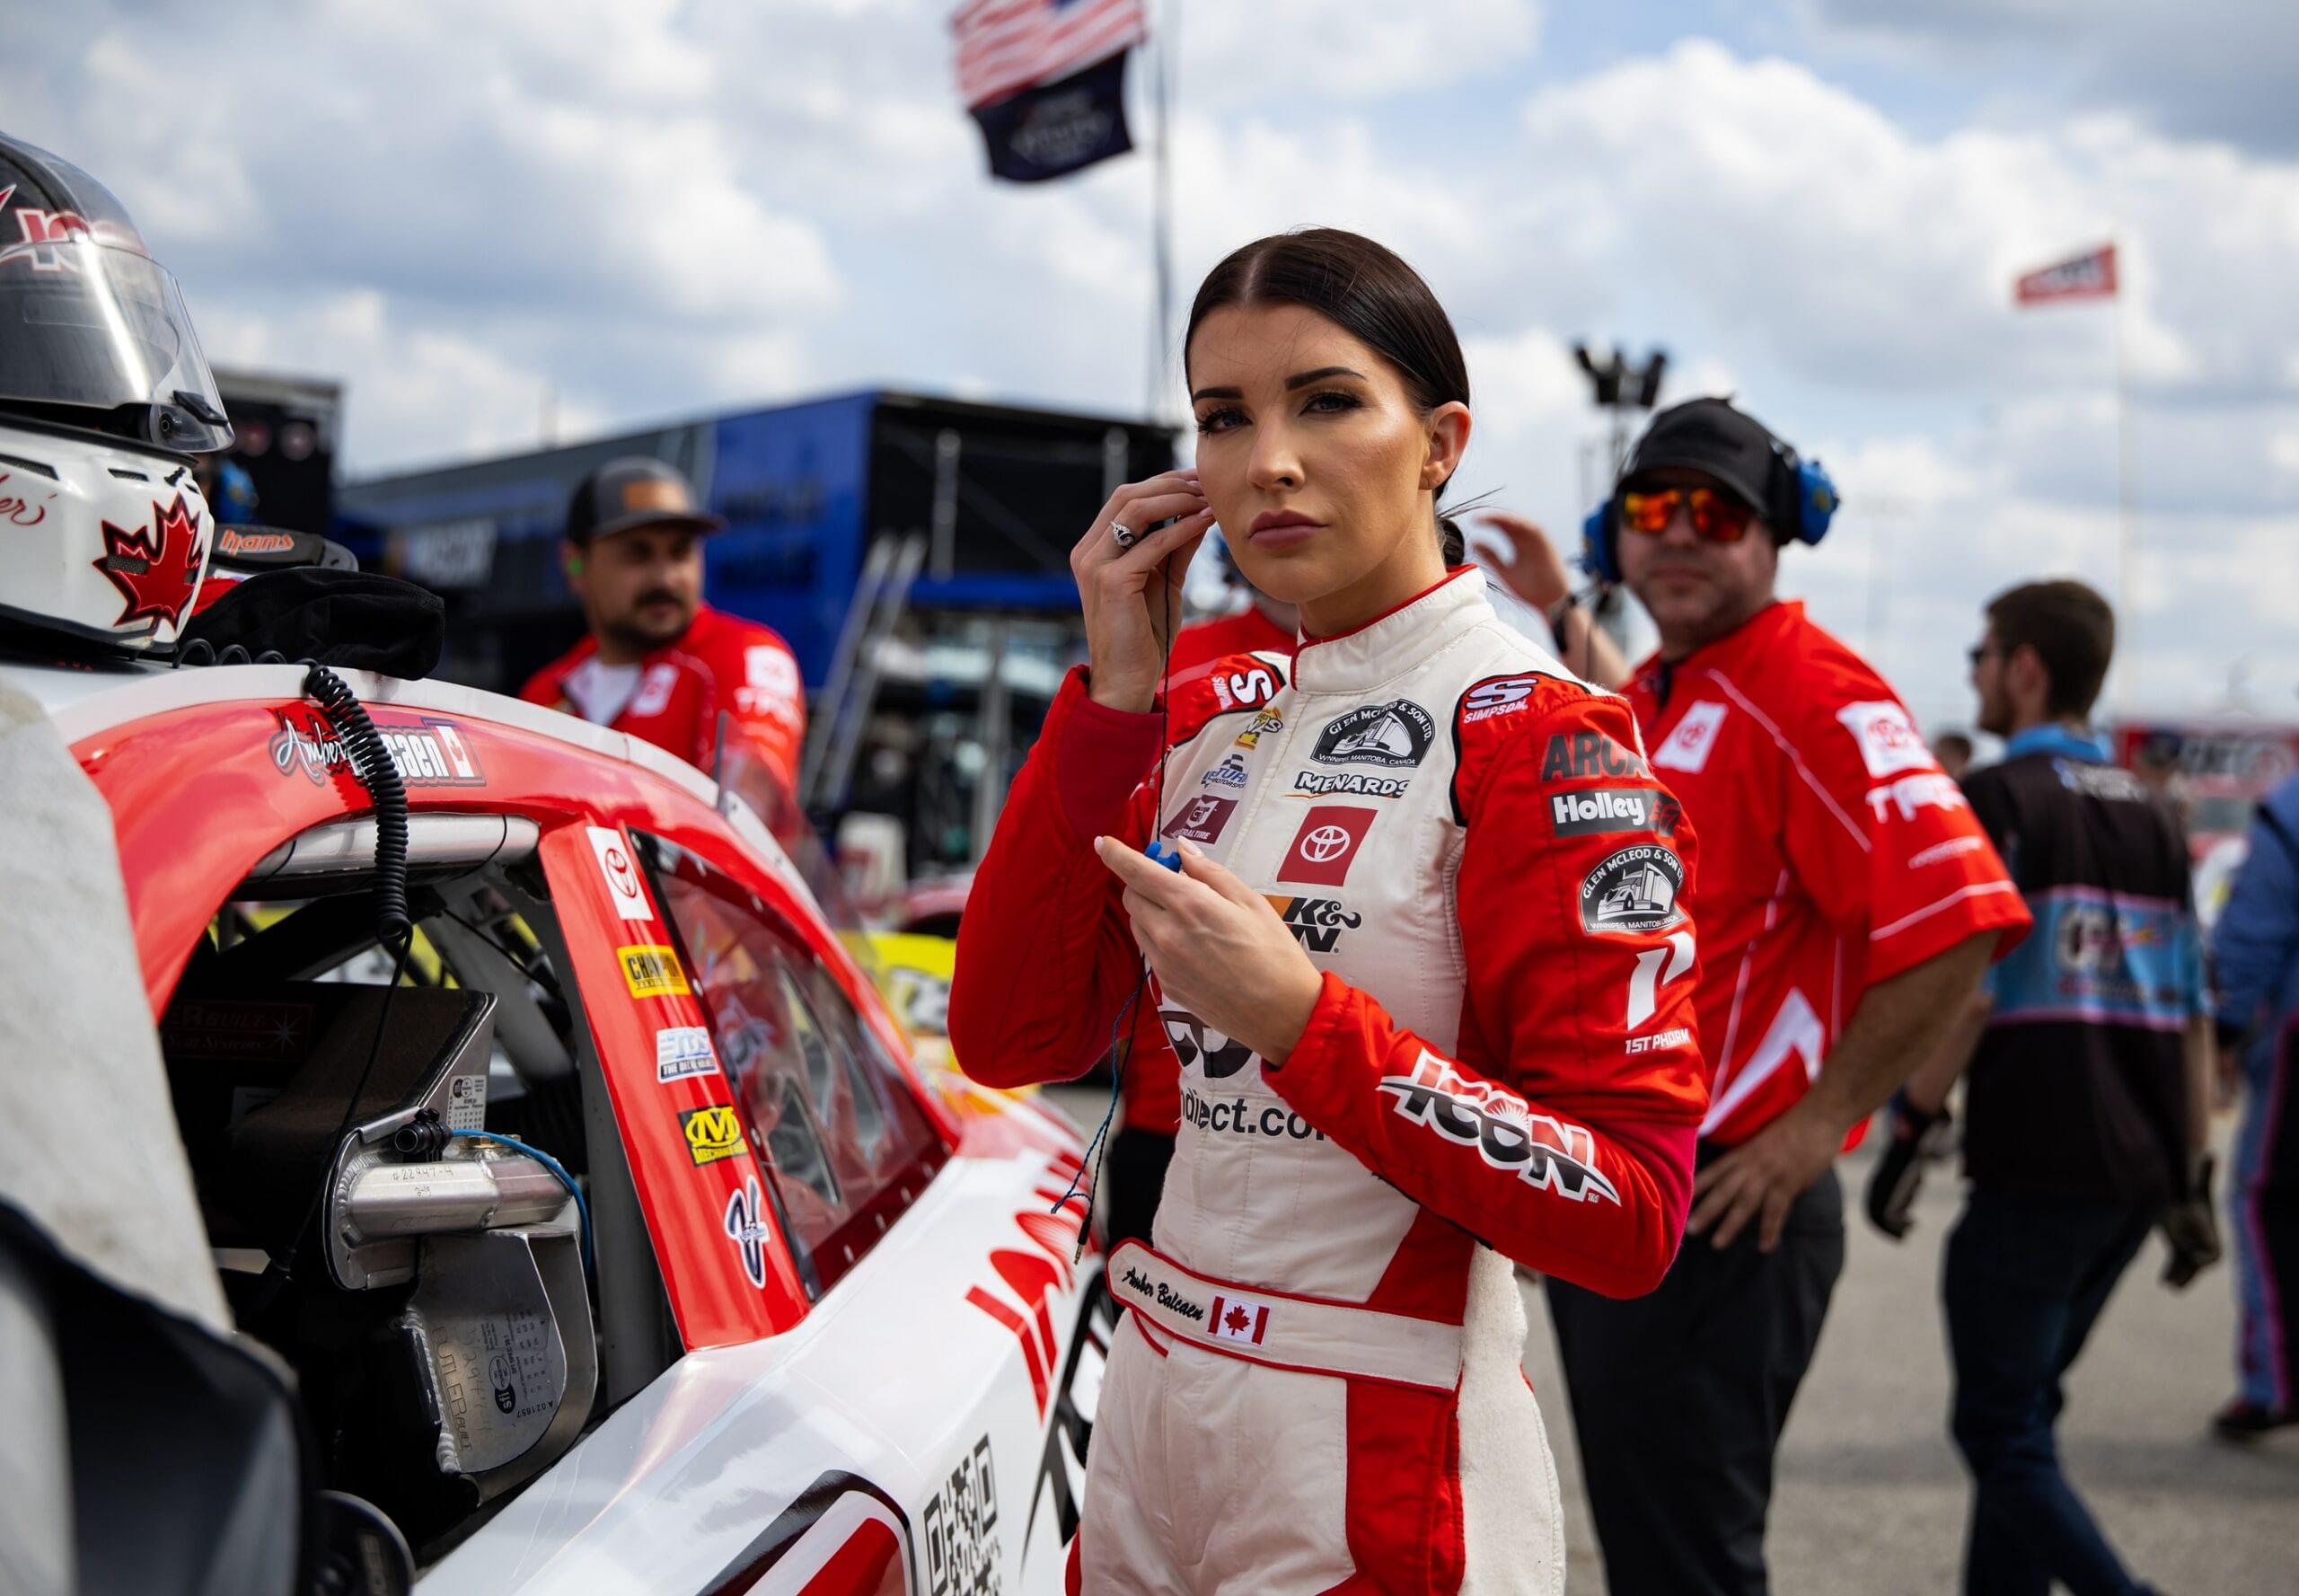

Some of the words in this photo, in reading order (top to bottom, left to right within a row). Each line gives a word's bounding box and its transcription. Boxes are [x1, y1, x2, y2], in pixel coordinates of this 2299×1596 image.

[1407, 705, 1424, 726] SON
[1463, 698, 1528, 724] SIMPSON
[273, 718, 348, 778] Amber
[1541, 732, 1651, 782] ARCA
[1553, 792, 1646, 826] Holley
[1582, 868, 1608, 899] GLEN
[1606, 847, 1652, 872] MCLEOD
[1653, 849, 1662, 860] &
[1662, 852, 1680, 872] SON
[1625, 1036, 1652, 1054] 1ST
[1122, 1266, 1154, 1297] Amber
[1157, 1282, 1204, 1321] Balcaen
